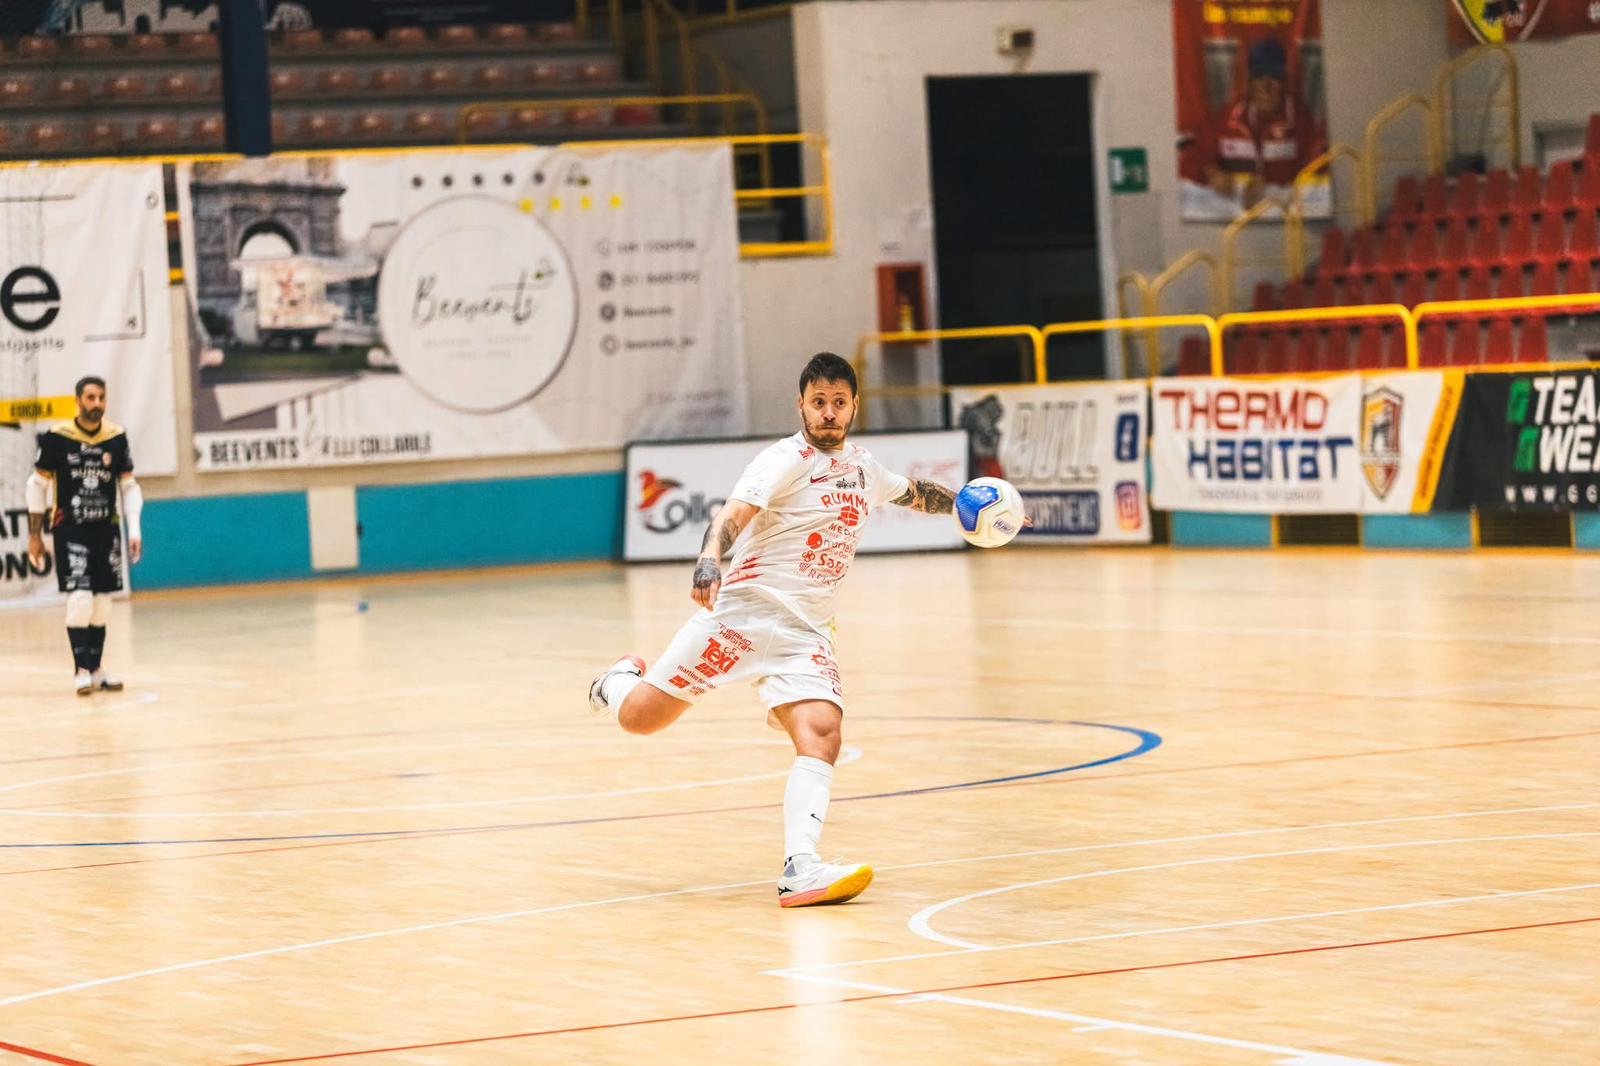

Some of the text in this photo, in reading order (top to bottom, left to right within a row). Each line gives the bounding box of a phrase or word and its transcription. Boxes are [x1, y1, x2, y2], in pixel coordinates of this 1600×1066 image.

[1533, 375, 1600, 425] TEA
[210, 438, 299, 463] BEEVENTS
[701, 637, 740, 673] Texi
